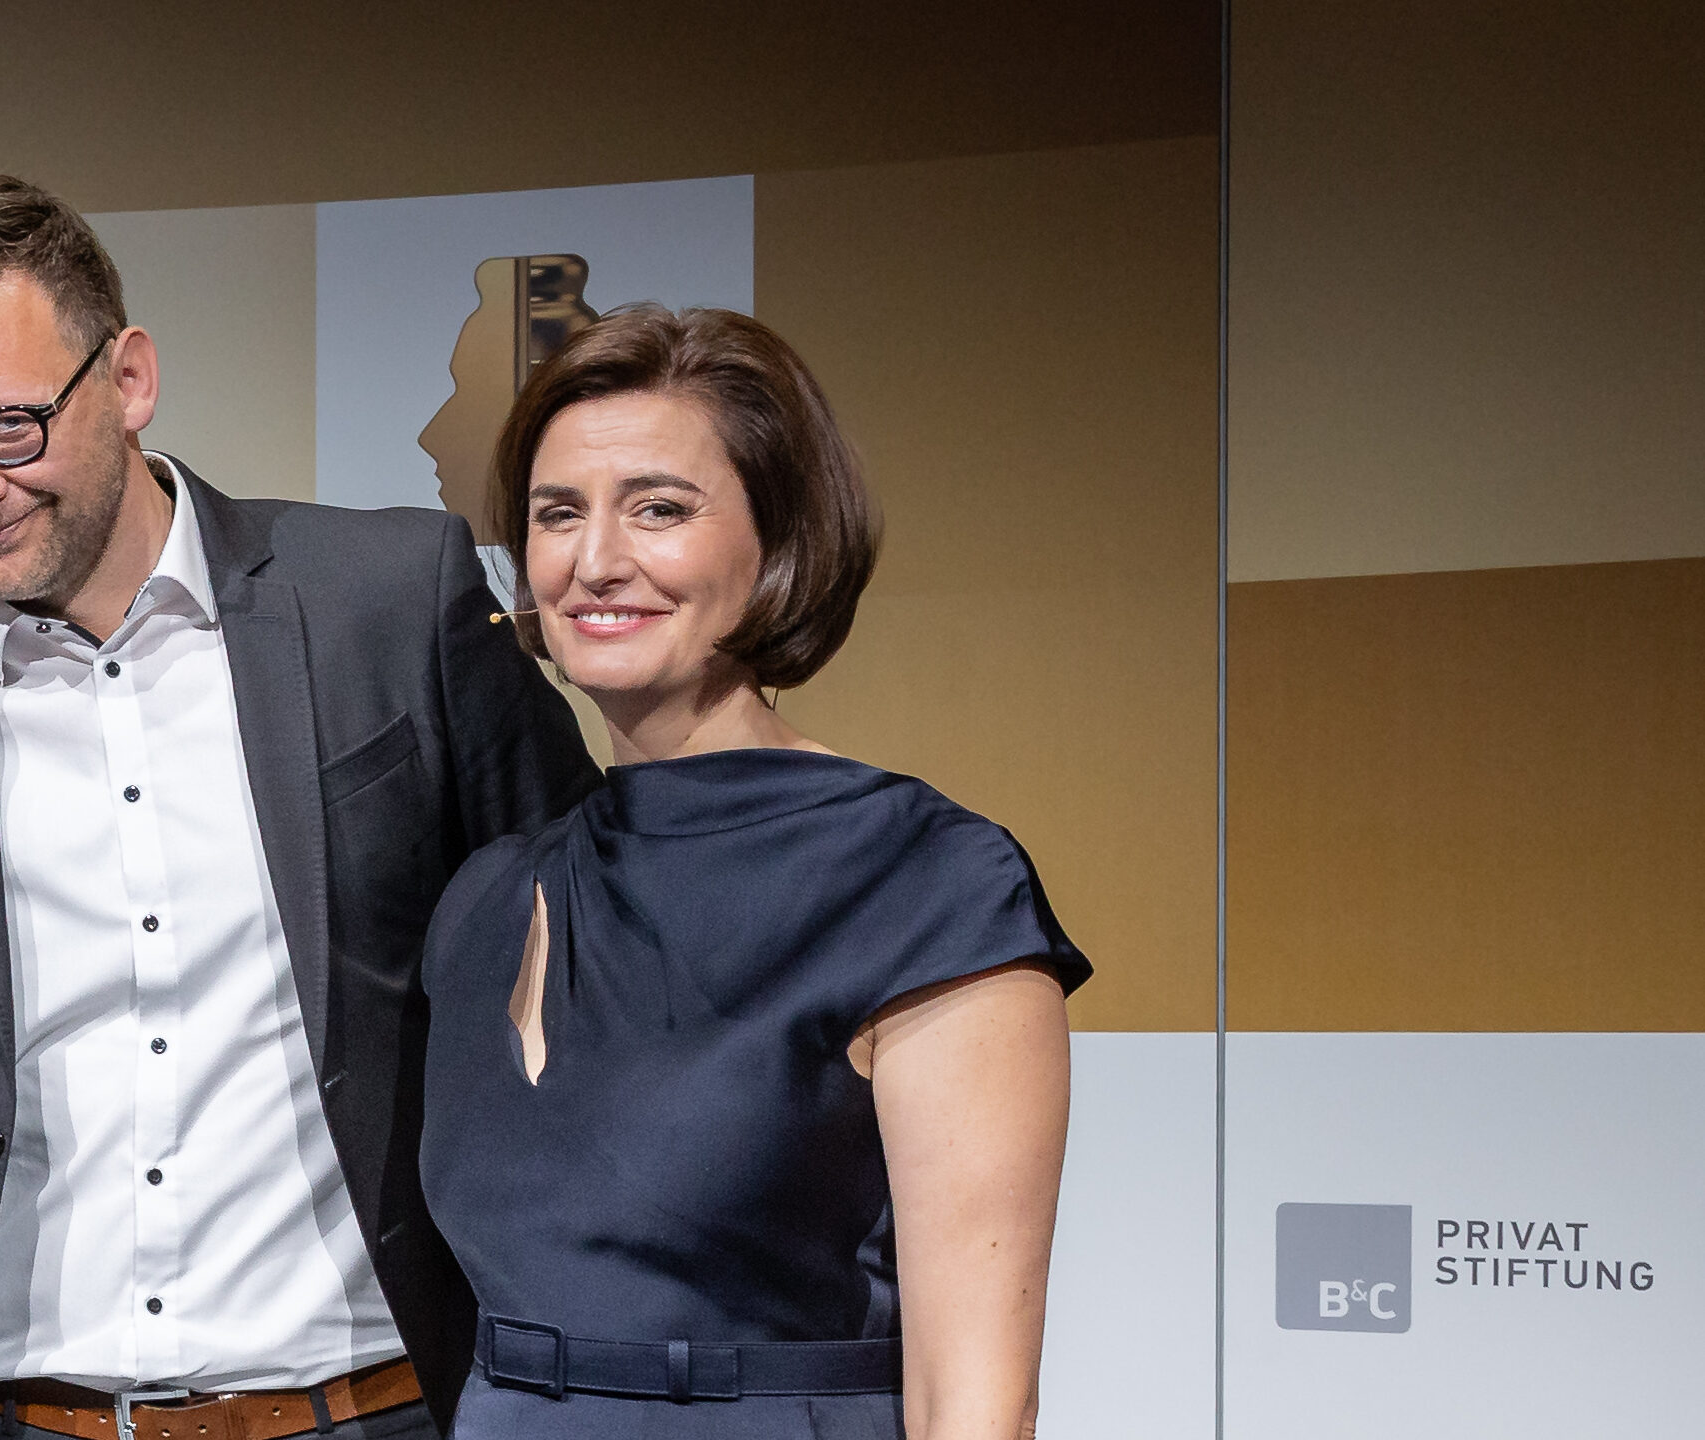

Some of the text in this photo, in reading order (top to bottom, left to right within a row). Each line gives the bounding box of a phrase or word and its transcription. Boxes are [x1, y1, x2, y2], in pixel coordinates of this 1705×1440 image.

[1436, 1218, 1589, 1252] PRIVAT
[1435, 1256, 1655, 1292] STIFTUNG
[1318, 1278, 1397, 1320] B&C
